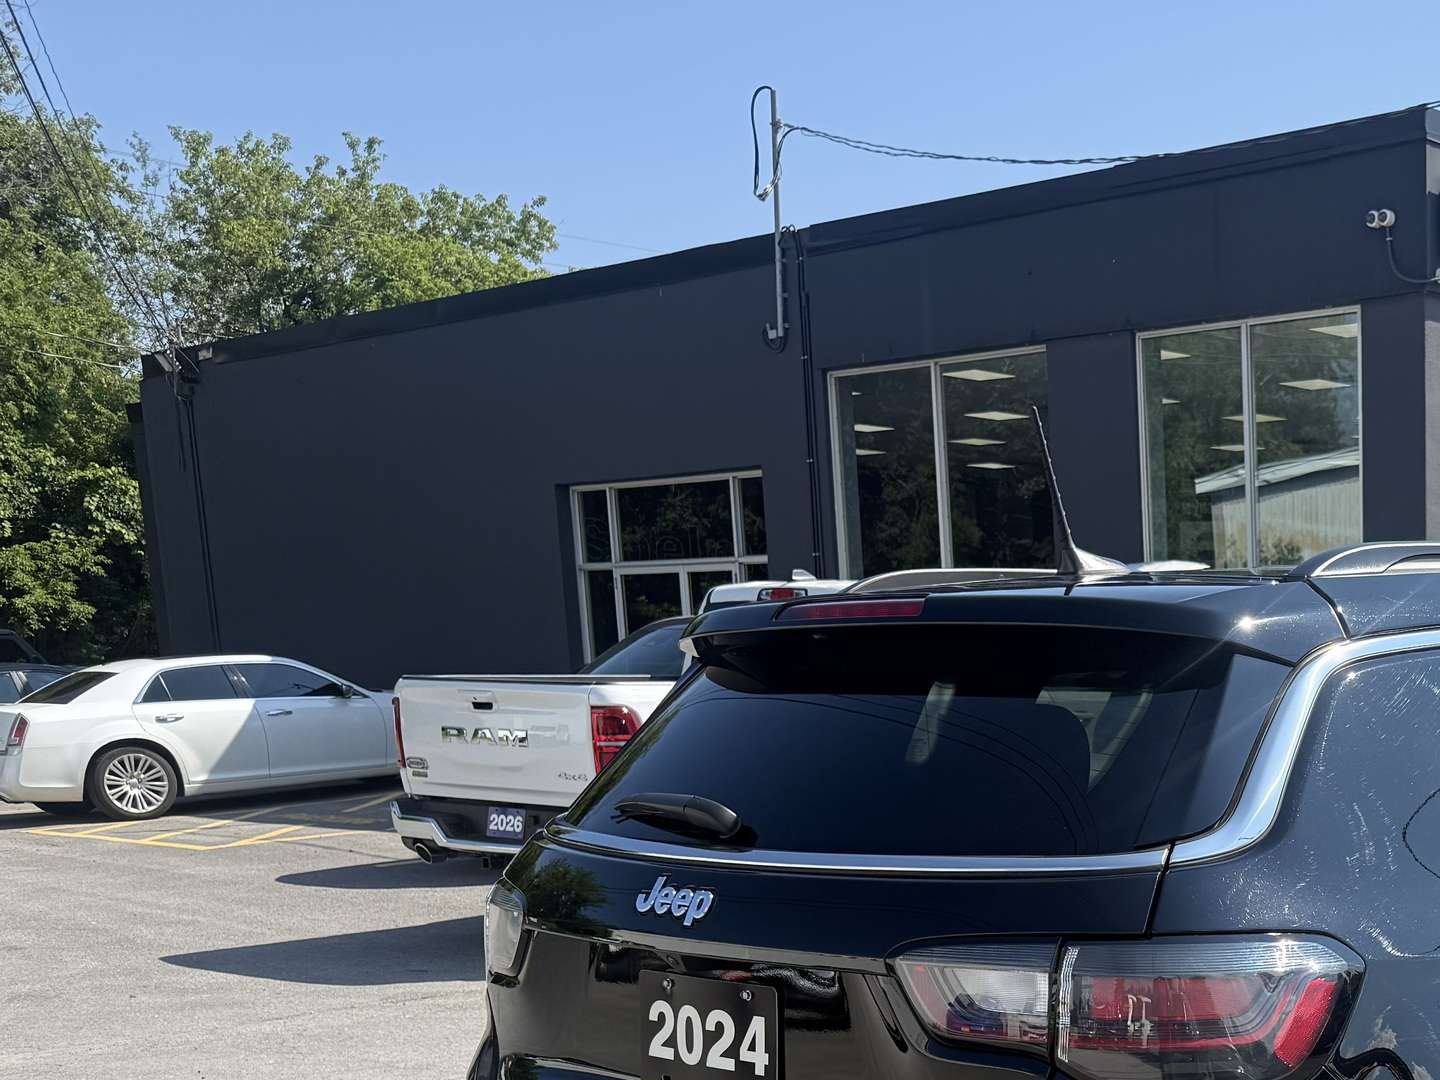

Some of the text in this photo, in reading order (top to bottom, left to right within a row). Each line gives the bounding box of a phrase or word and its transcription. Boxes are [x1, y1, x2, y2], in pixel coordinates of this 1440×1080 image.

[441, 725, 529, 748] RAM
[489, 813, 524, 832] 2026
[635, 875, 715, 926] Jeep
[648, 1000, 769, 1076] 2024
